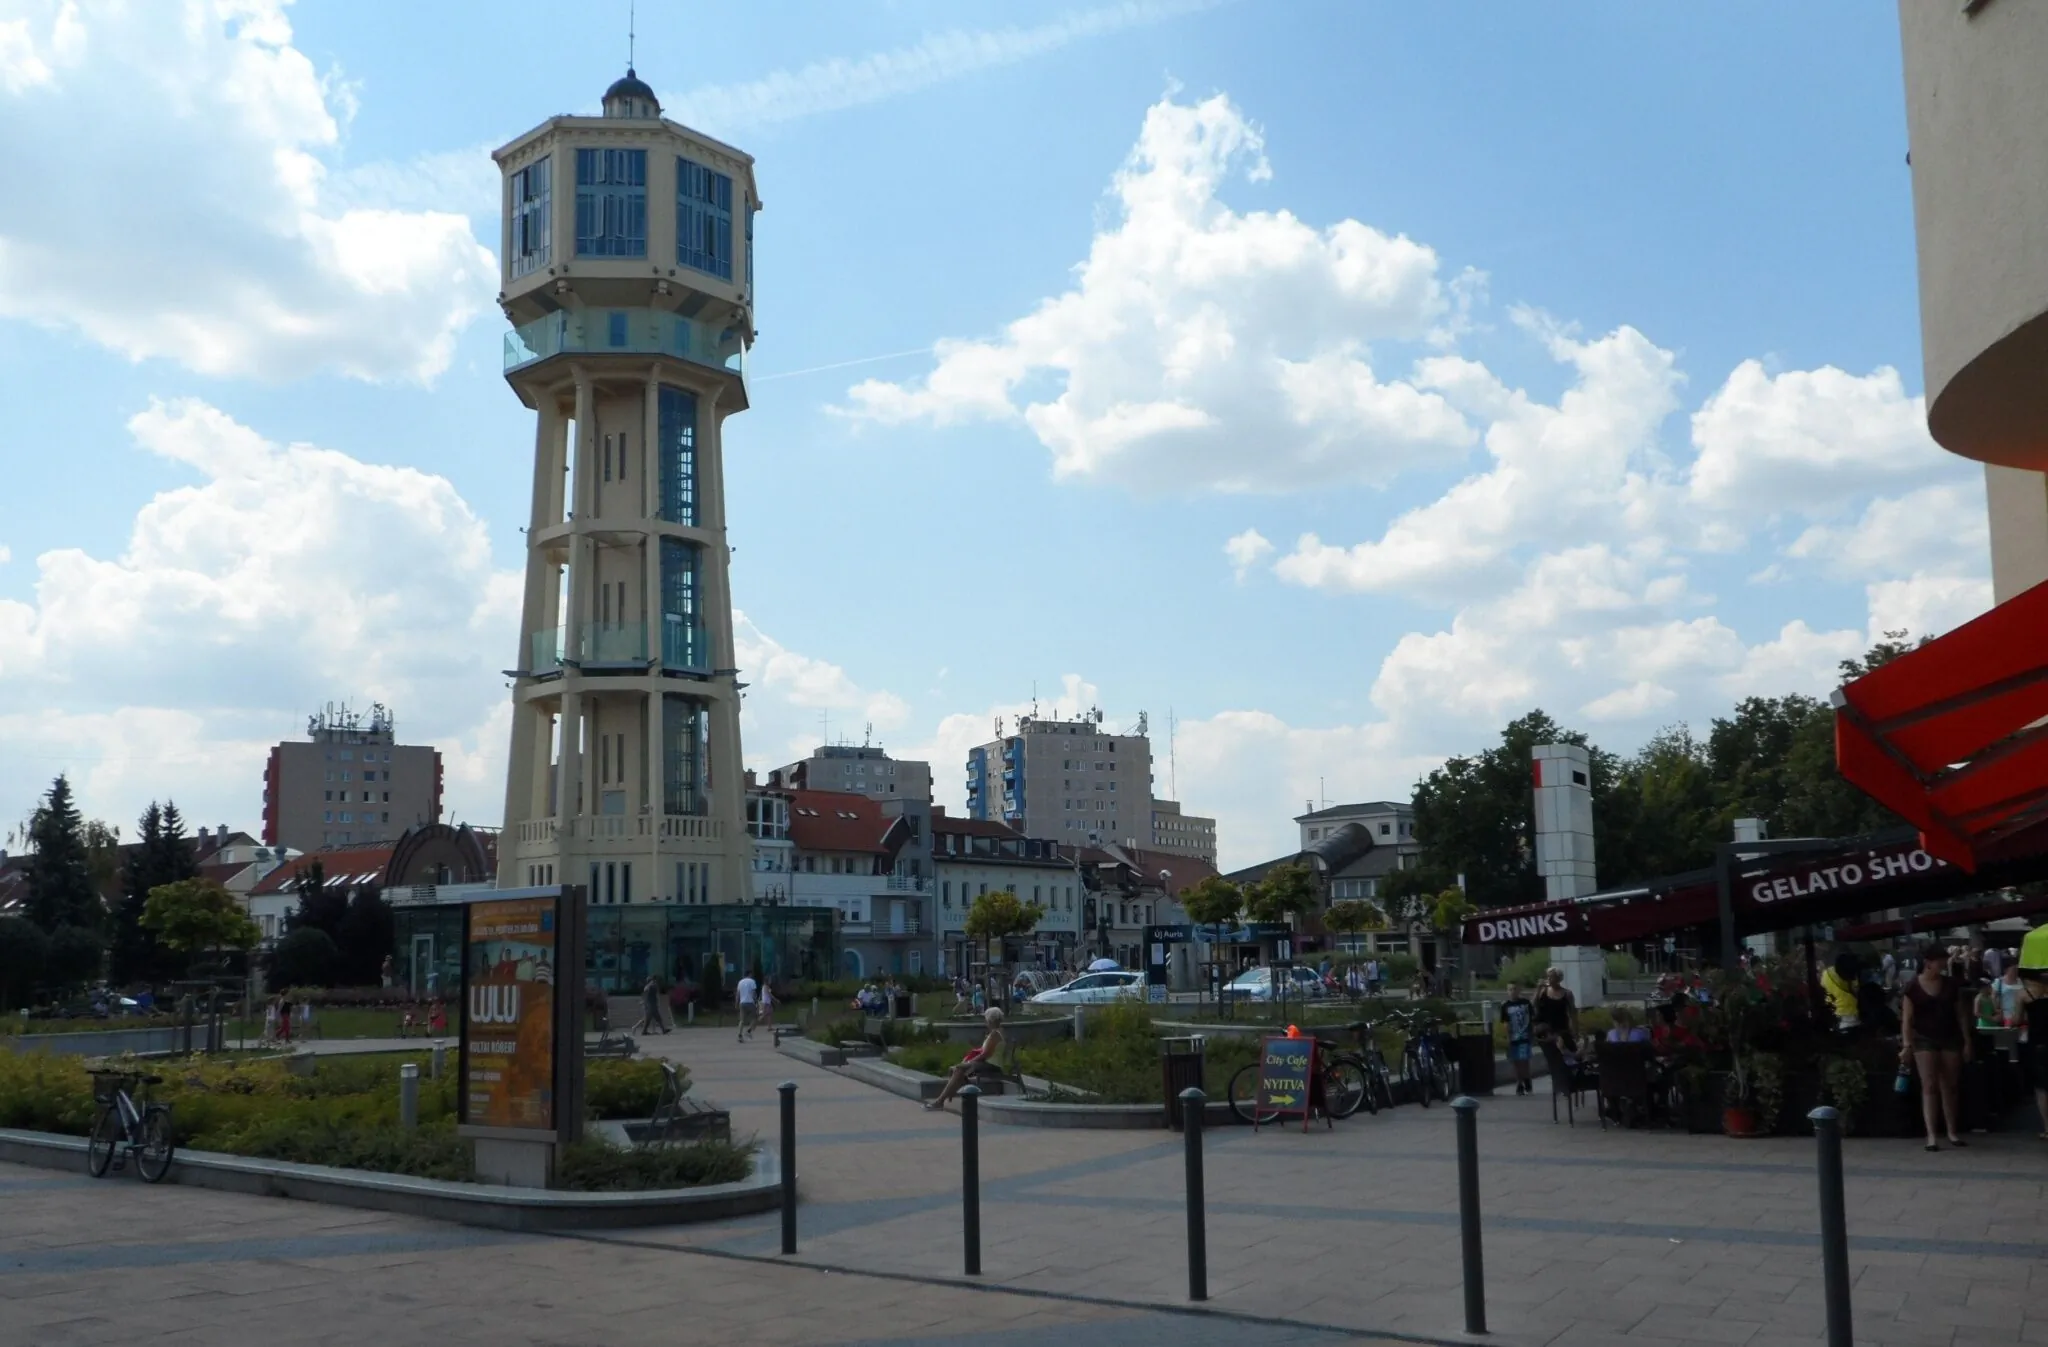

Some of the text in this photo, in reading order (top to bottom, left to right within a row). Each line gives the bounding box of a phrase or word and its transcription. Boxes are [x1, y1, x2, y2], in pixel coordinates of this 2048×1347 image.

[1752, 849, 1947, 904] GELATO SHO
[1478, 911, 1569, 942] DRINKS
[470, 984, 517, 1024] LULU
[1266, 1055, 1308, 1068] City Cafe
[1263, 1078, 1305, 1091] NYITVA
